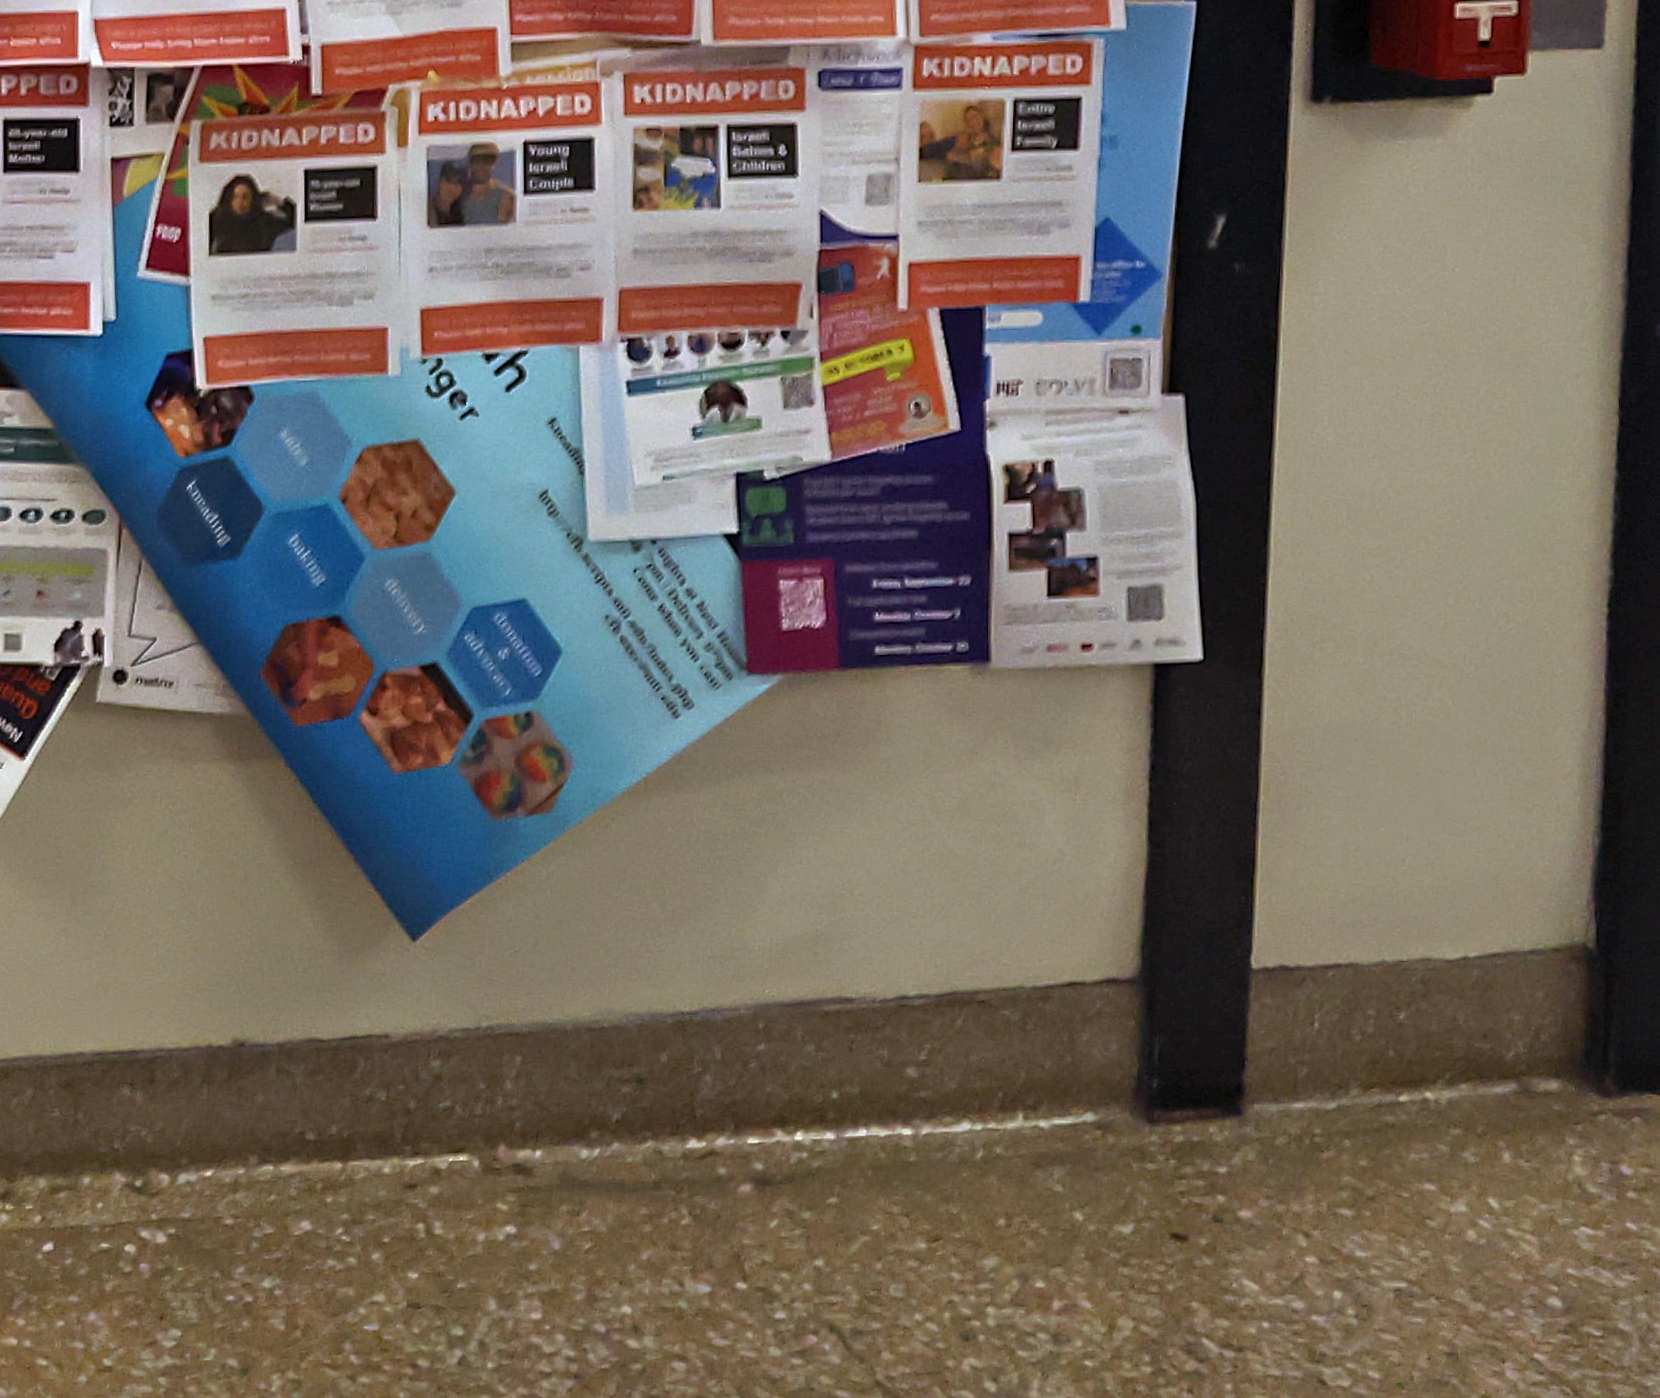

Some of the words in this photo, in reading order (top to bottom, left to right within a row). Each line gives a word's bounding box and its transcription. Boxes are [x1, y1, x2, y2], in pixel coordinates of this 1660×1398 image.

[921, 53, 1084, 80] KIDNAPPED
[632, 78, 797, 105] KIDNAPPED
[426, 93, 593, 123] KIDNAPPED
[208, 121, 377, 150] KIDNAPPED
[527, 143, 572, 160] Young
[527, 160, 569, 176] Israeli
[528, 174, 576, 191] Couple
[287, 533, 326, 587] baking
